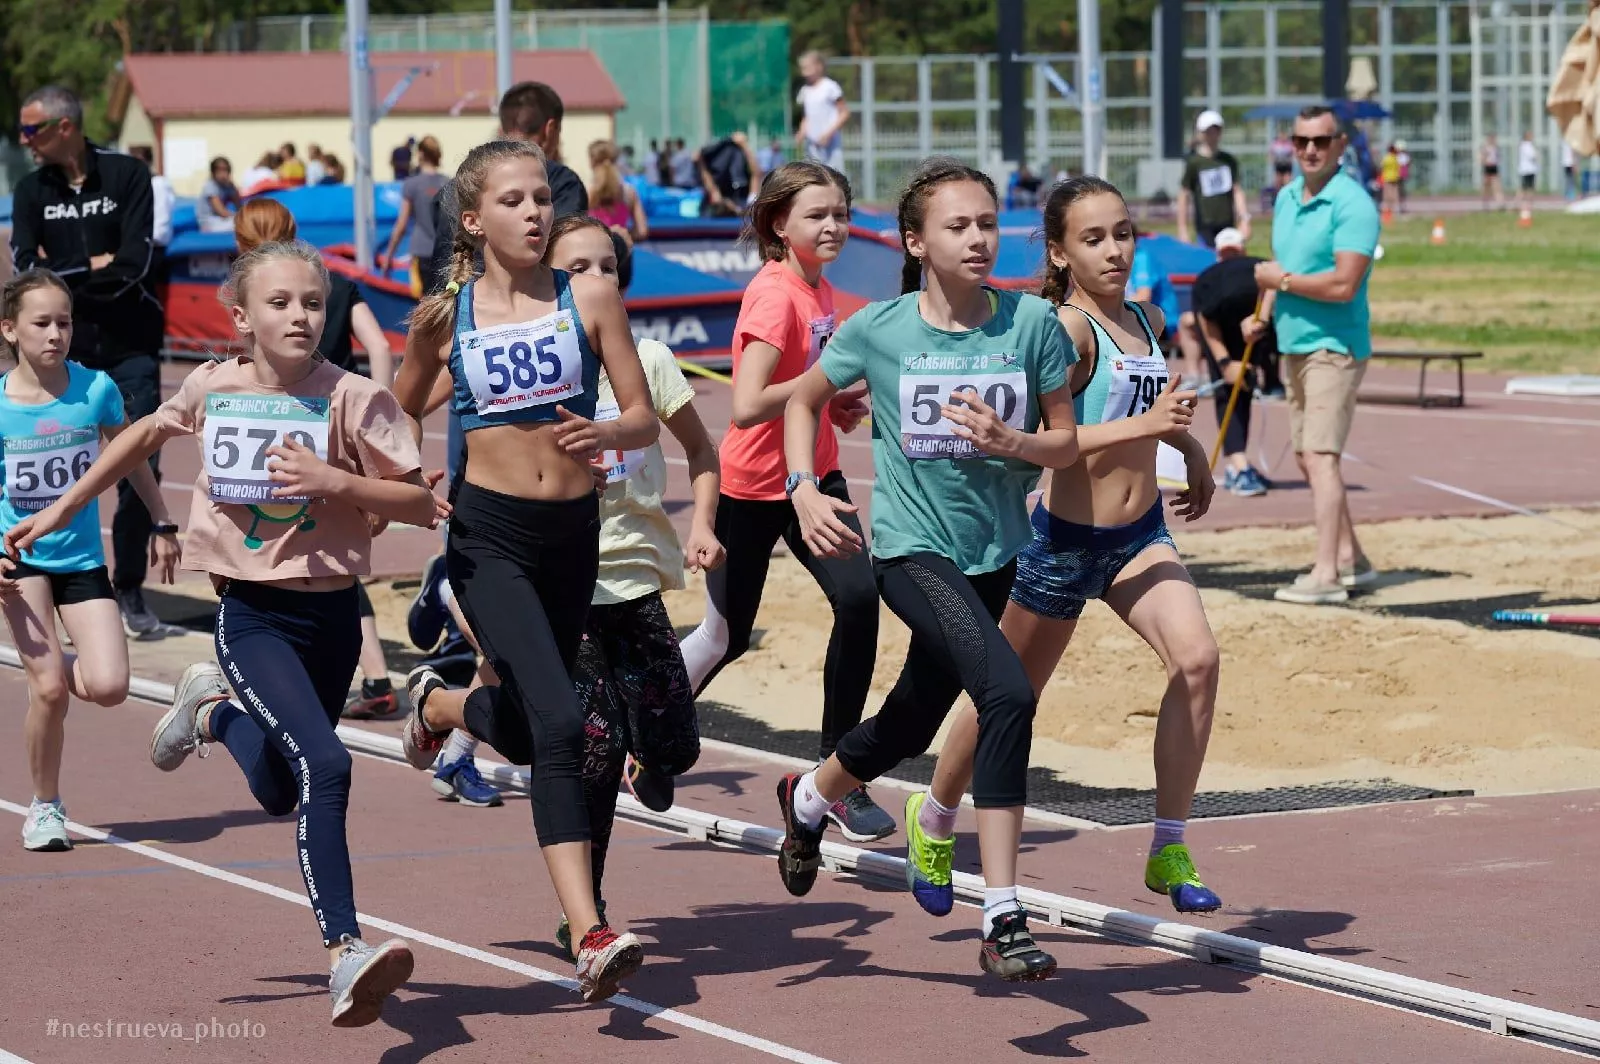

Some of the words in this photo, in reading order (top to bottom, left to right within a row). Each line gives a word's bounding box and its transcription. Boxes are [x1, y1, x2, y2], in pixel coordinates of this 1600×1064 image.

[44, 199, 102, 220] CRAFT
[483, 335, 562, 395] 585
[15, 450, 91, 492] 566
[218, 603, 230, 657] AWESOME
[228, 661, 245, 684] STAY
[243, 686, 279, 729] AWESOME
[588, 711, 609, 730] FUN
[281, 732, 301, 754] STAY
[298, 756, 311, 805] AWESOME
[298, 814, 307, 841] STAY
[300, 848, 319, 901] AWESOME
